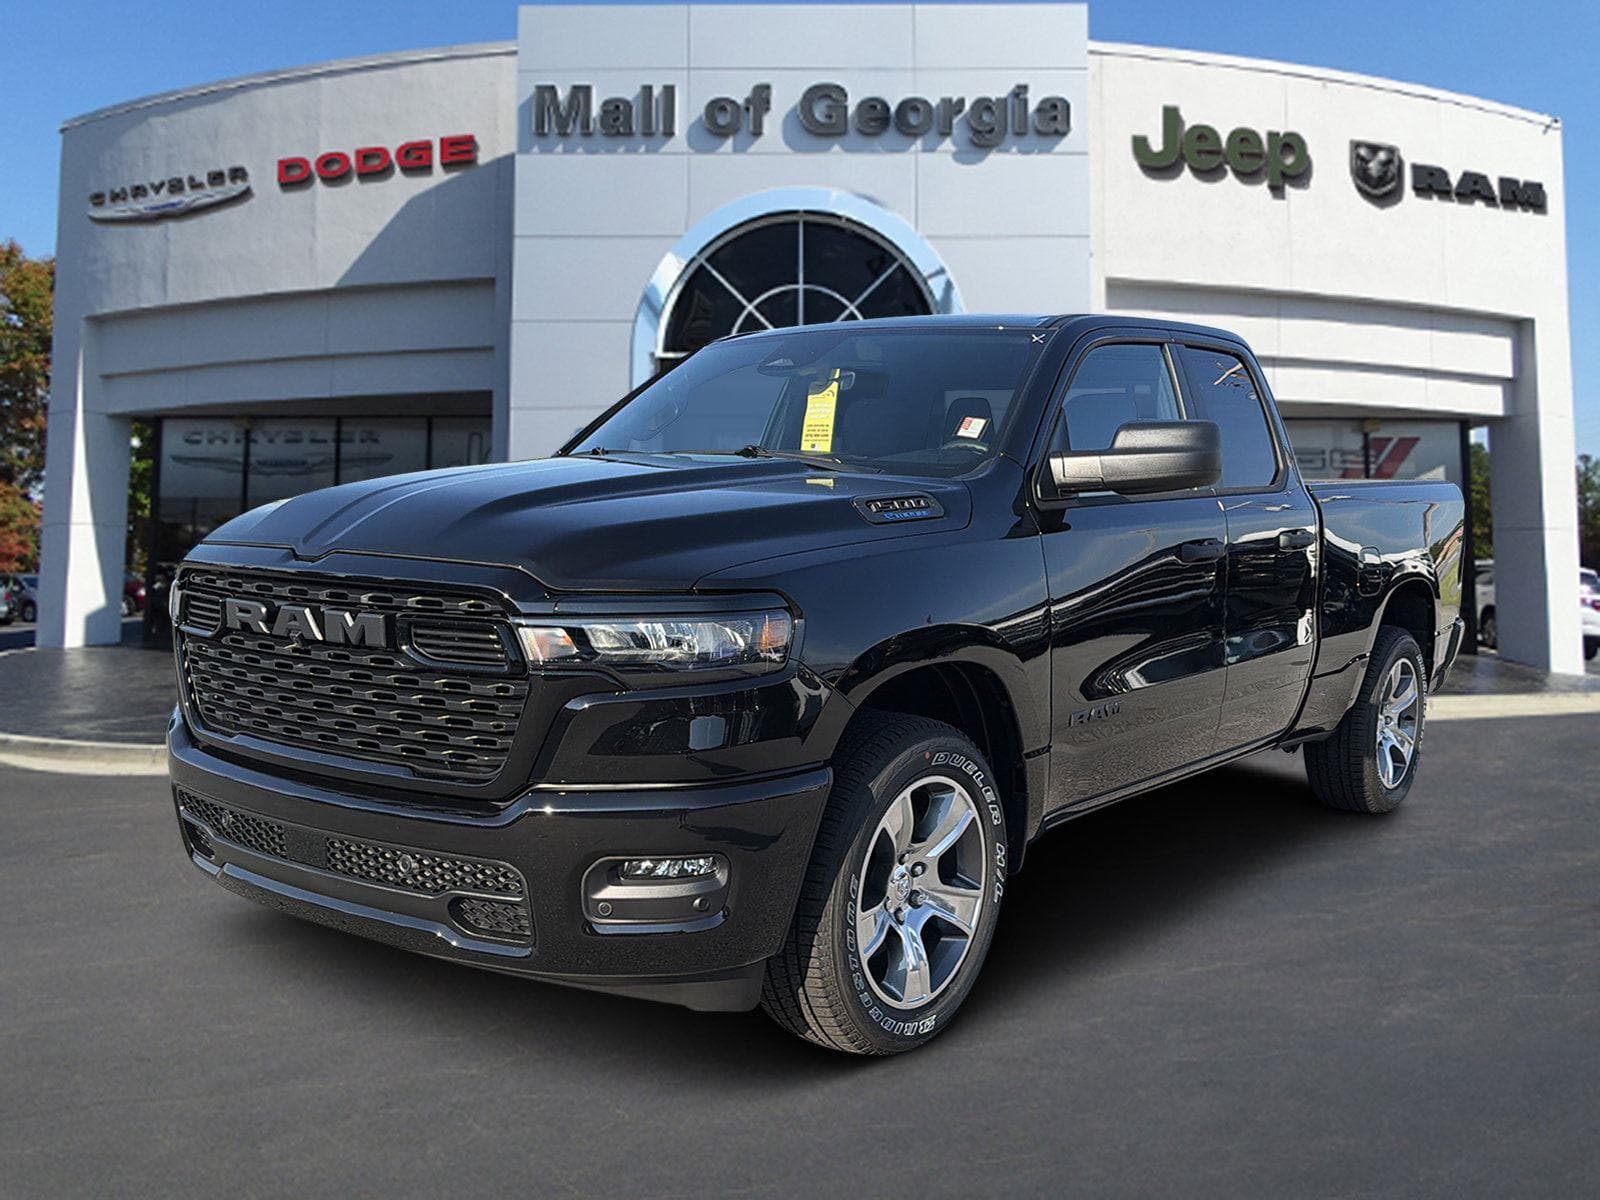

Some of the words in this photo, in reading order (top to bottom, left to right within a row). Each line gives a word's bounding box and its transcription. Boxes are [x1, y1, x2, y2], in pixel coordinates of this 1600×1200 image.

[533, 83, 676, 137] Mall
[704, 82, 772, 137] of
[799, 82, 1072, 149] Georgia
[276, 133, 479, 189] DODGE
[1131, 104, 1310, 196] Jeep
[88, 166, 249, 207] CHRYSLER
[1410, 163, 1549, 214] RAM
[225, 597, 388, 648] RAM
[931, 751, 1002, 826] DUELER
